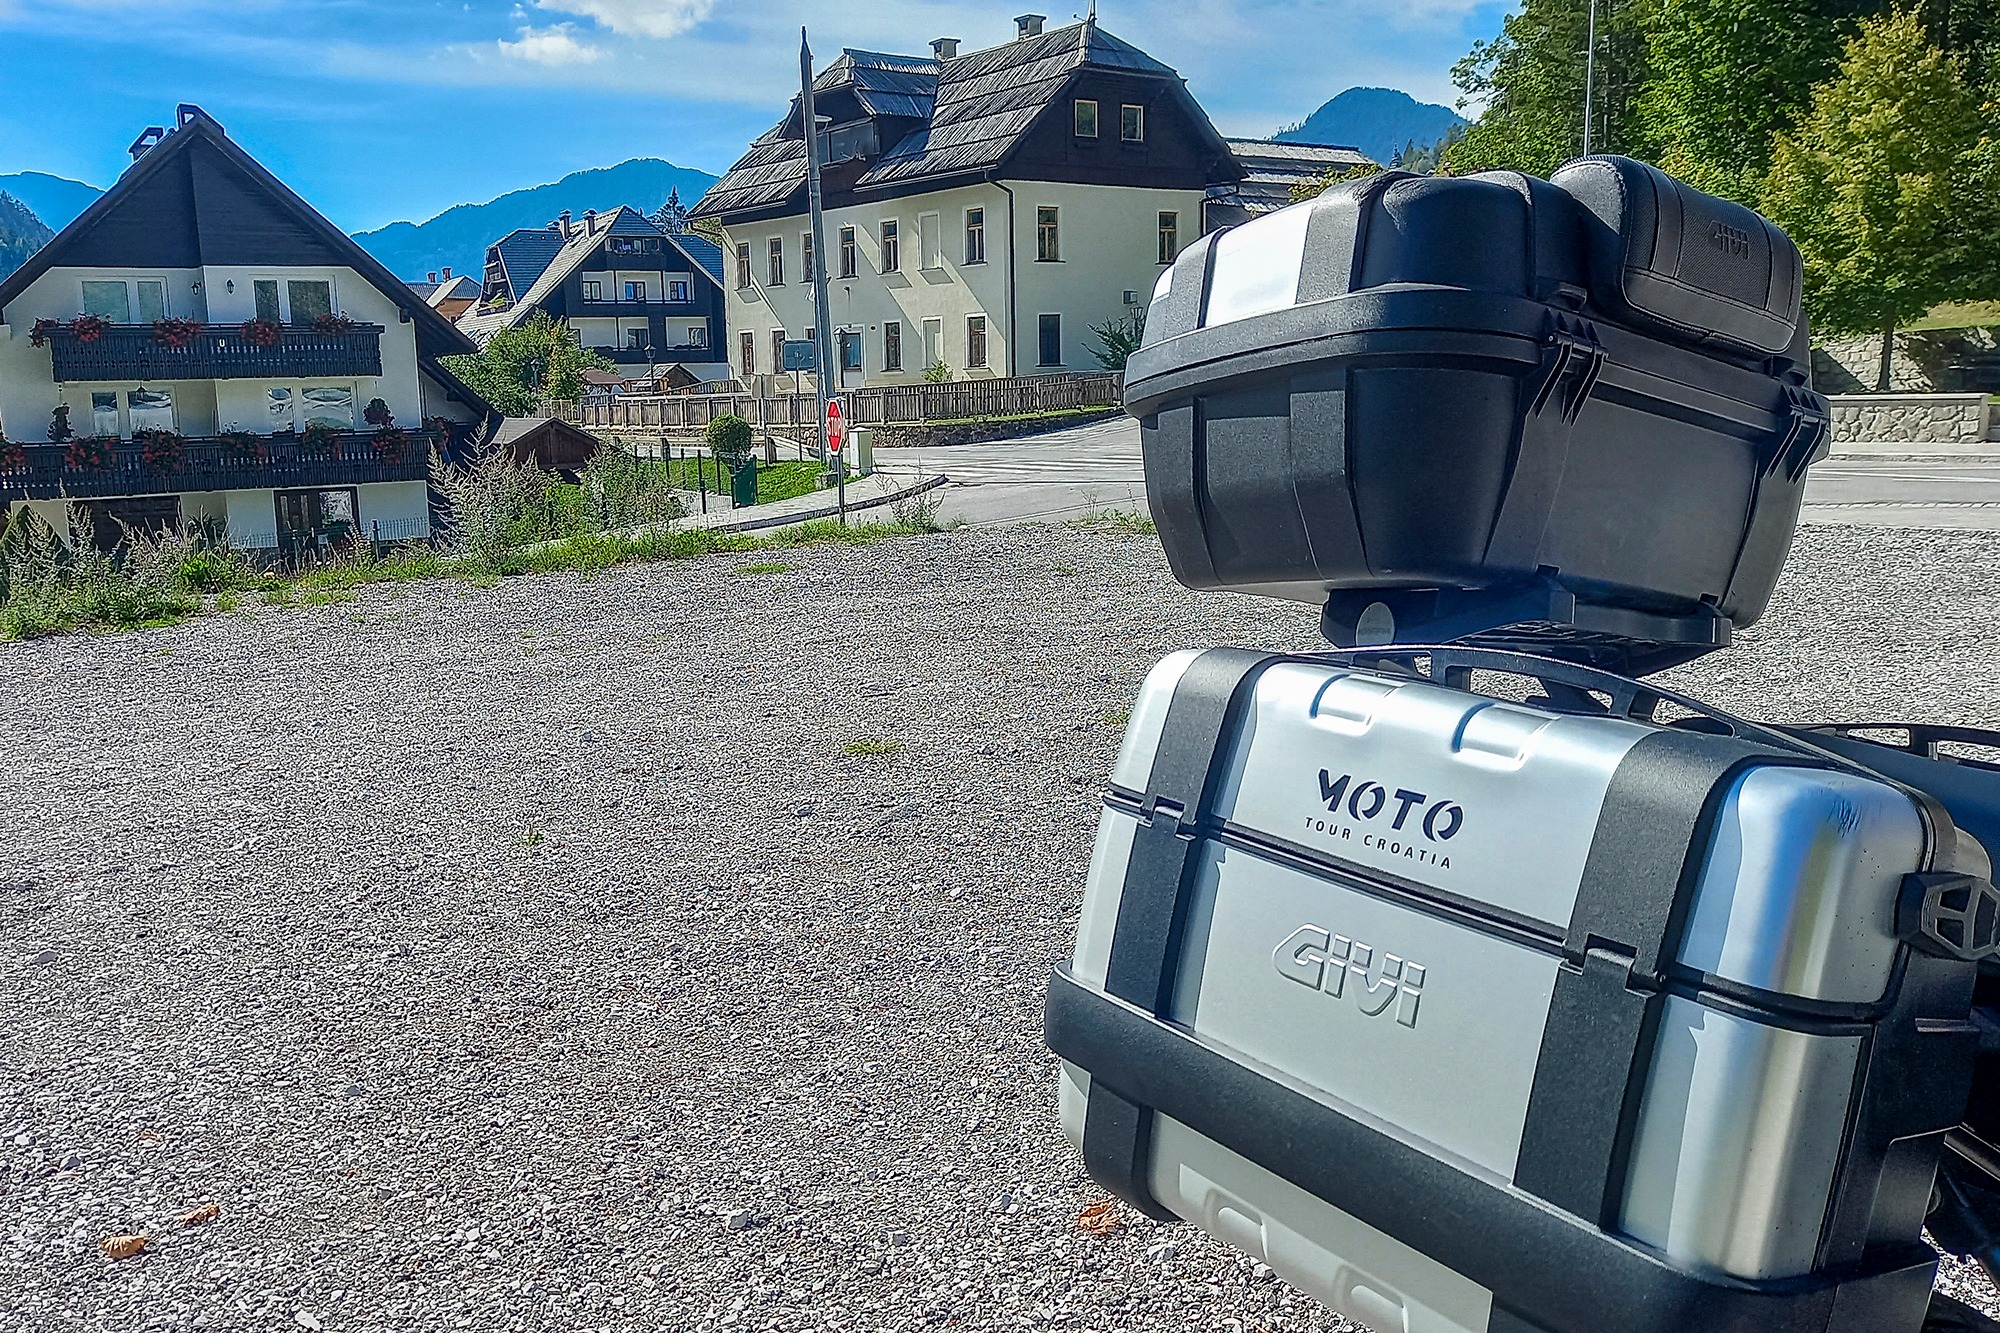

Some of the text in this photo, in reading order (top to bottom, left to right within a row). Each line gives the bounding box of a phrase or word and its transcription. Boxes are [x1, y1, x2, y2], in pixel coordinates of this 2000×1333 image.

[827, 416, 842, 437] STOP
[1318, 768, 1464, 842] MOTO
[1305, 816, 1451, 869] TOUR CROATIA
